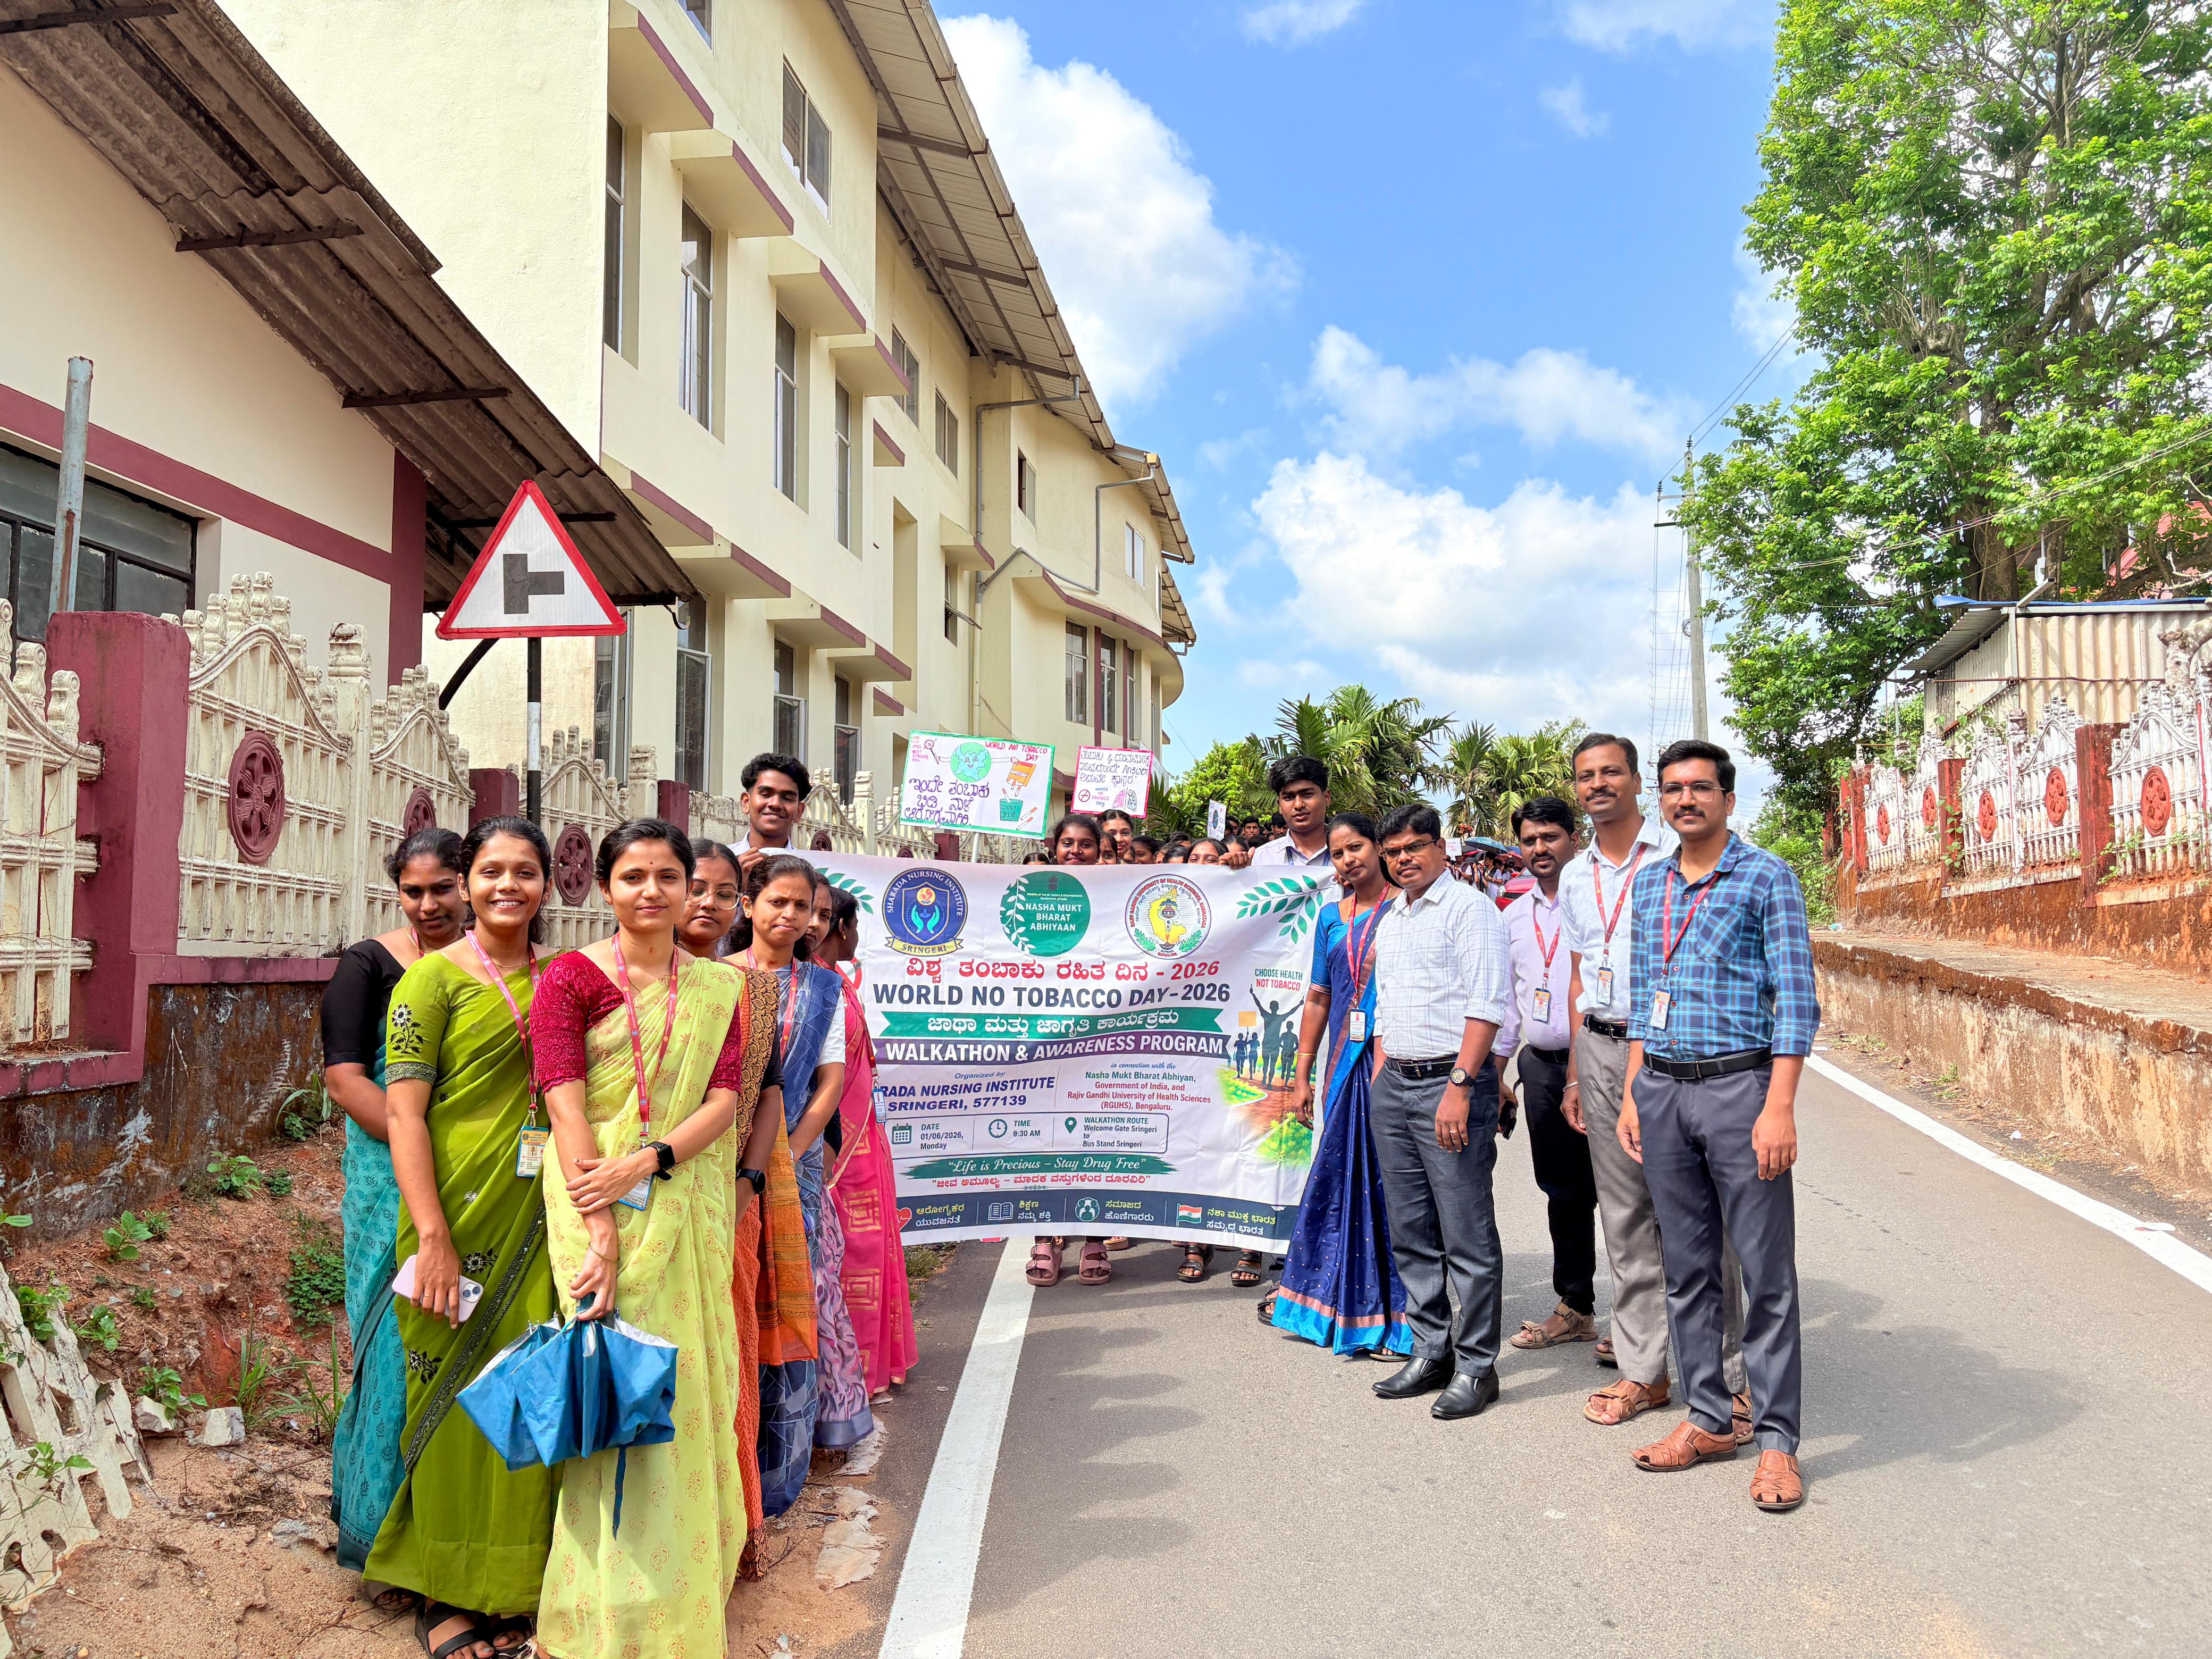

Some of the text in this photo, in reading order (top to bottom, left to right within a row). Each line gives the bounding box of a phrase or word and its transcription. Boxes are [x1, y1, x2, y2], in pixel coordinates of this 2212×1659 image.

[985, 741, 1006, 750] WORLD
[1021, 744, 1048, 754] TOBACCO
[887, 871, 963, 917] SHARADA NURSING INSTITUTE
[1025, 903, 1082, 912] NASHA MUKT
[1036, 913, 1071, 921] BHARAT
[1030, 923, 1076, 931] ABHIYAAN
[902, 944, 947, 953] SRINGERI
[907, 957, 941, 983] ವಿಶ್ವ
[959, 959, 1045, 979] ತಂಬಾಕು
[1057, 959, 1105, 980] ರಹಿತ
[1115, 961, 1148, 981] ದಿನ
[1170, 960, 1220, 980] 2026
[1255, 969, 1303, 980] CHOOSE HEALTH
[1256, 978, 1301, 991] NOT TOBACCO
[873, 984, 963, 1006] WORLD
[971, 986, 1005, 1007] NO
[1013, 987, 1122, 1009] TOBACCO
[927, 1009, 1179, 1038] ಜಾಥಾ ಮತ್ತು ಜಾಗೃತಿ ಕಾರ್ಯಕ್ರಮ
[885, 1035, 1223, 1061] WALKATHON & AWARENESS PROGRAM
[1162, 1073, 1196, 1083] Abhiyan,
[876, 1077, 1055, 1097] RADA NURSING INSTITUTE
[1150, 1082, 1169, 1091] India,
[1067, 1091, 1084, 1101] Rajiv
[1112, 1092, 1146, 1101] University
[1157, 1093, 1178, 1101] Health
[1180, 1094, 1211, 1103] Sciences
[888, 1099, 968, 1112] SRINGERI,
[973, 1095, 1027, 1108] 577139
[1101, 1101, 1173, 1112] (RGUHS), Bengaluru.
[920, 1132, 964, 1141] 01/06/2026,
[949, 1160, 977, 1175] “Life
[981, 1160, 990, 1170] is
[993, 1159, 1040, 1170] Precious
[1054, 1157, 1079, 1171] Stay
[1083, 1157, 1112, 1171] Drug
[1116, 1157, 1146, 1169] Free”
[961, 1176, 1000, 1188] ಅಮೂಲ್ಯ
[1013, 1174, 1047, 1183] ಮಾದಕ
[1105, 1200, 1142, 1209] ಸಮಾಜದ
[916, 1215, 961, 1227] ಯುವಜನತೆ
[1018, 1211, 1037, 1222] ನಮ್ಮ
[1207, 1208, 1276, 1225] ನಶಾ ಮುಕ್ತ ಭಾರತ
[1238, 1225, 1264, 1235] ಭಾರತ
